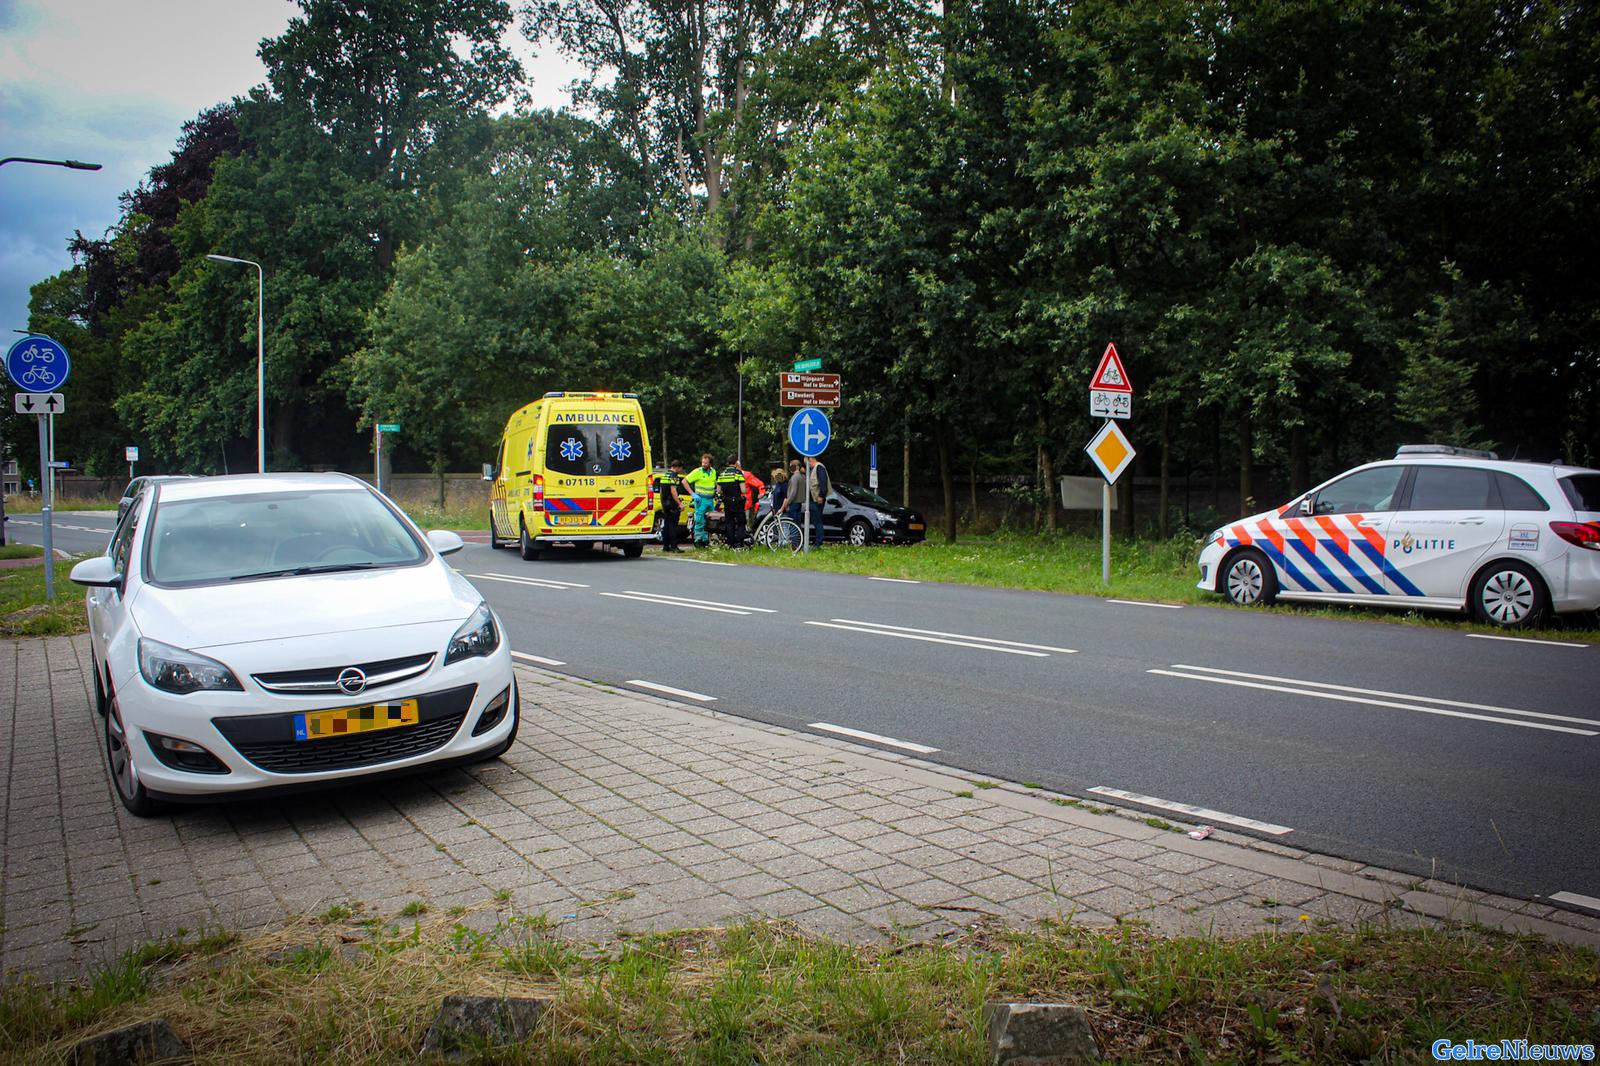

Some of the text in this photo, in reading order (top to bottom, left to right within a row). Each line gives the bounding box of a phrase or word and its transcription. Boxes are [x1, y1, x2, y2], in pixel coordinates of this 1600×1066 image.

[555, 413, 635, 423] AMBULANCE
[565, 478, 595, 486] 07118
[1393, 538, 1455, 553] POLITIE
